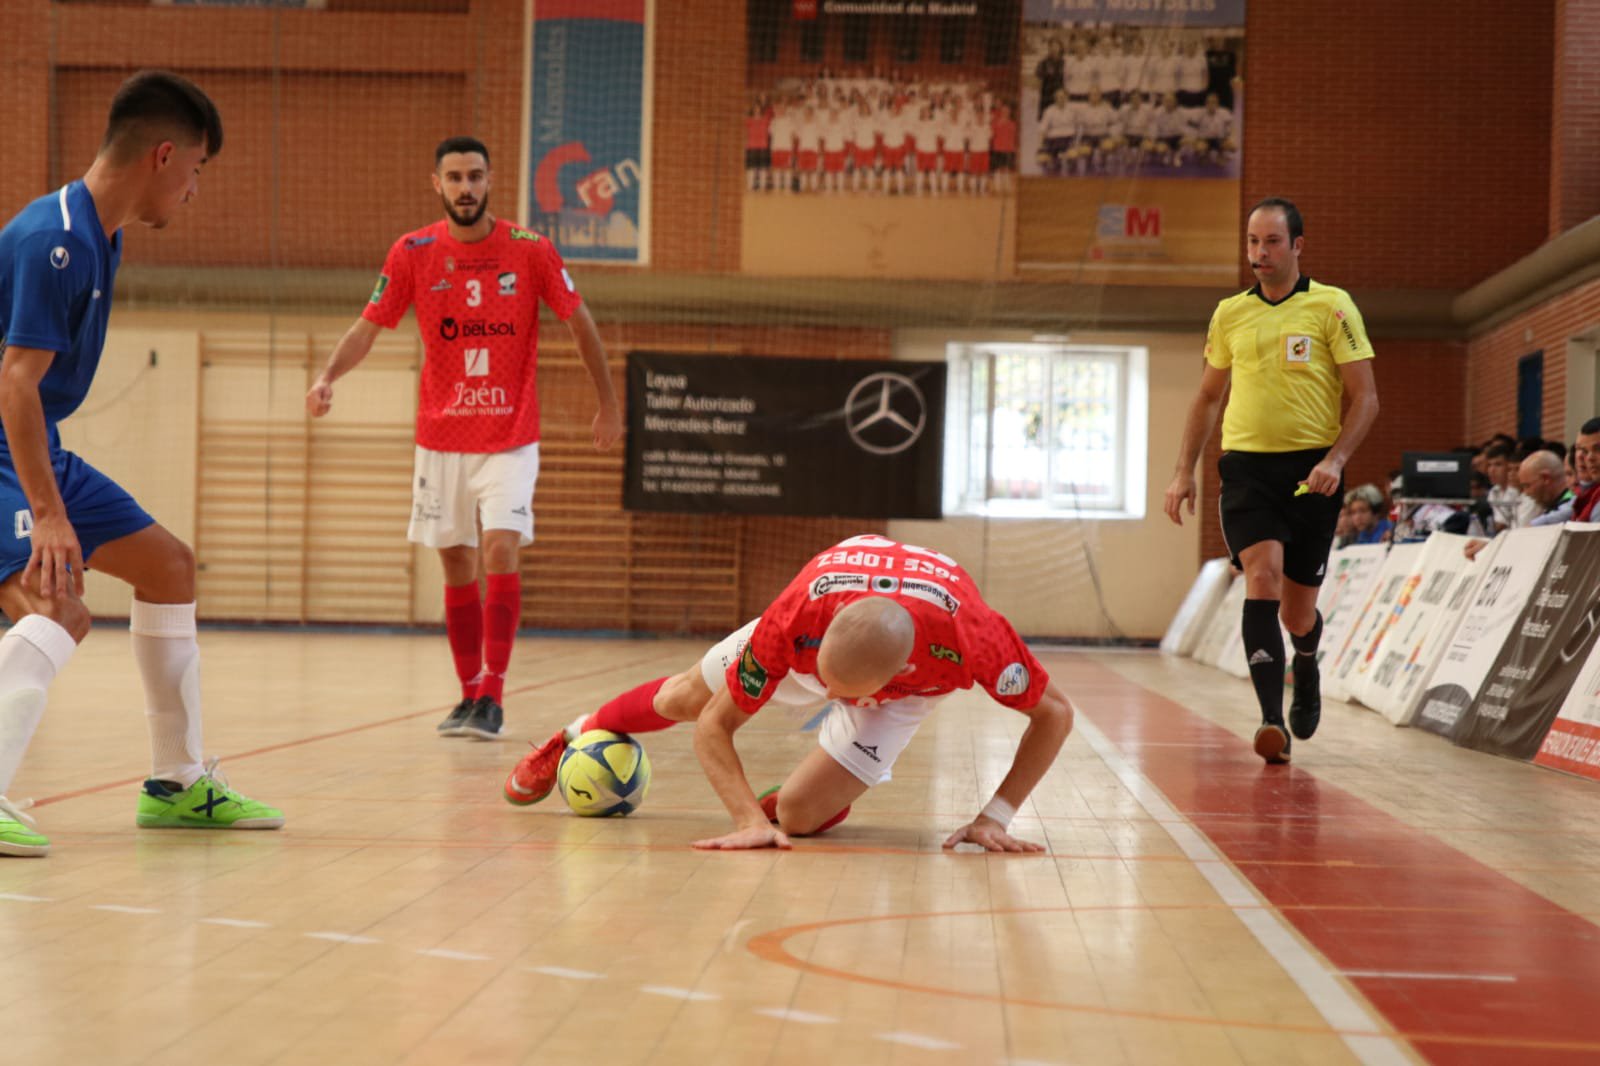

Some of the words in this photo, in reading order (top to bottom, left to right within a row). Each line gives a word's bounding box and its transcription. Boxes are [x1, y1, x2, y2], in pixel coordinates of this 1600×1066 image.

[823, 1, 904, 15] Comunidad
[907, 2, 925, 15] de
[928, 1, 978, 15] Madrid
[465, 279, 482, 307] 3
[646, 368, 688, 391] Leyva
[452, 381, 506, 407] Jaén
[646, 391, 682, 410] Taller
[683, 394, 755, 414] Autorizado
[644, 414, 748, 435] Mercedes-Benz
[816, 550, 894, 570] LOPEZ
